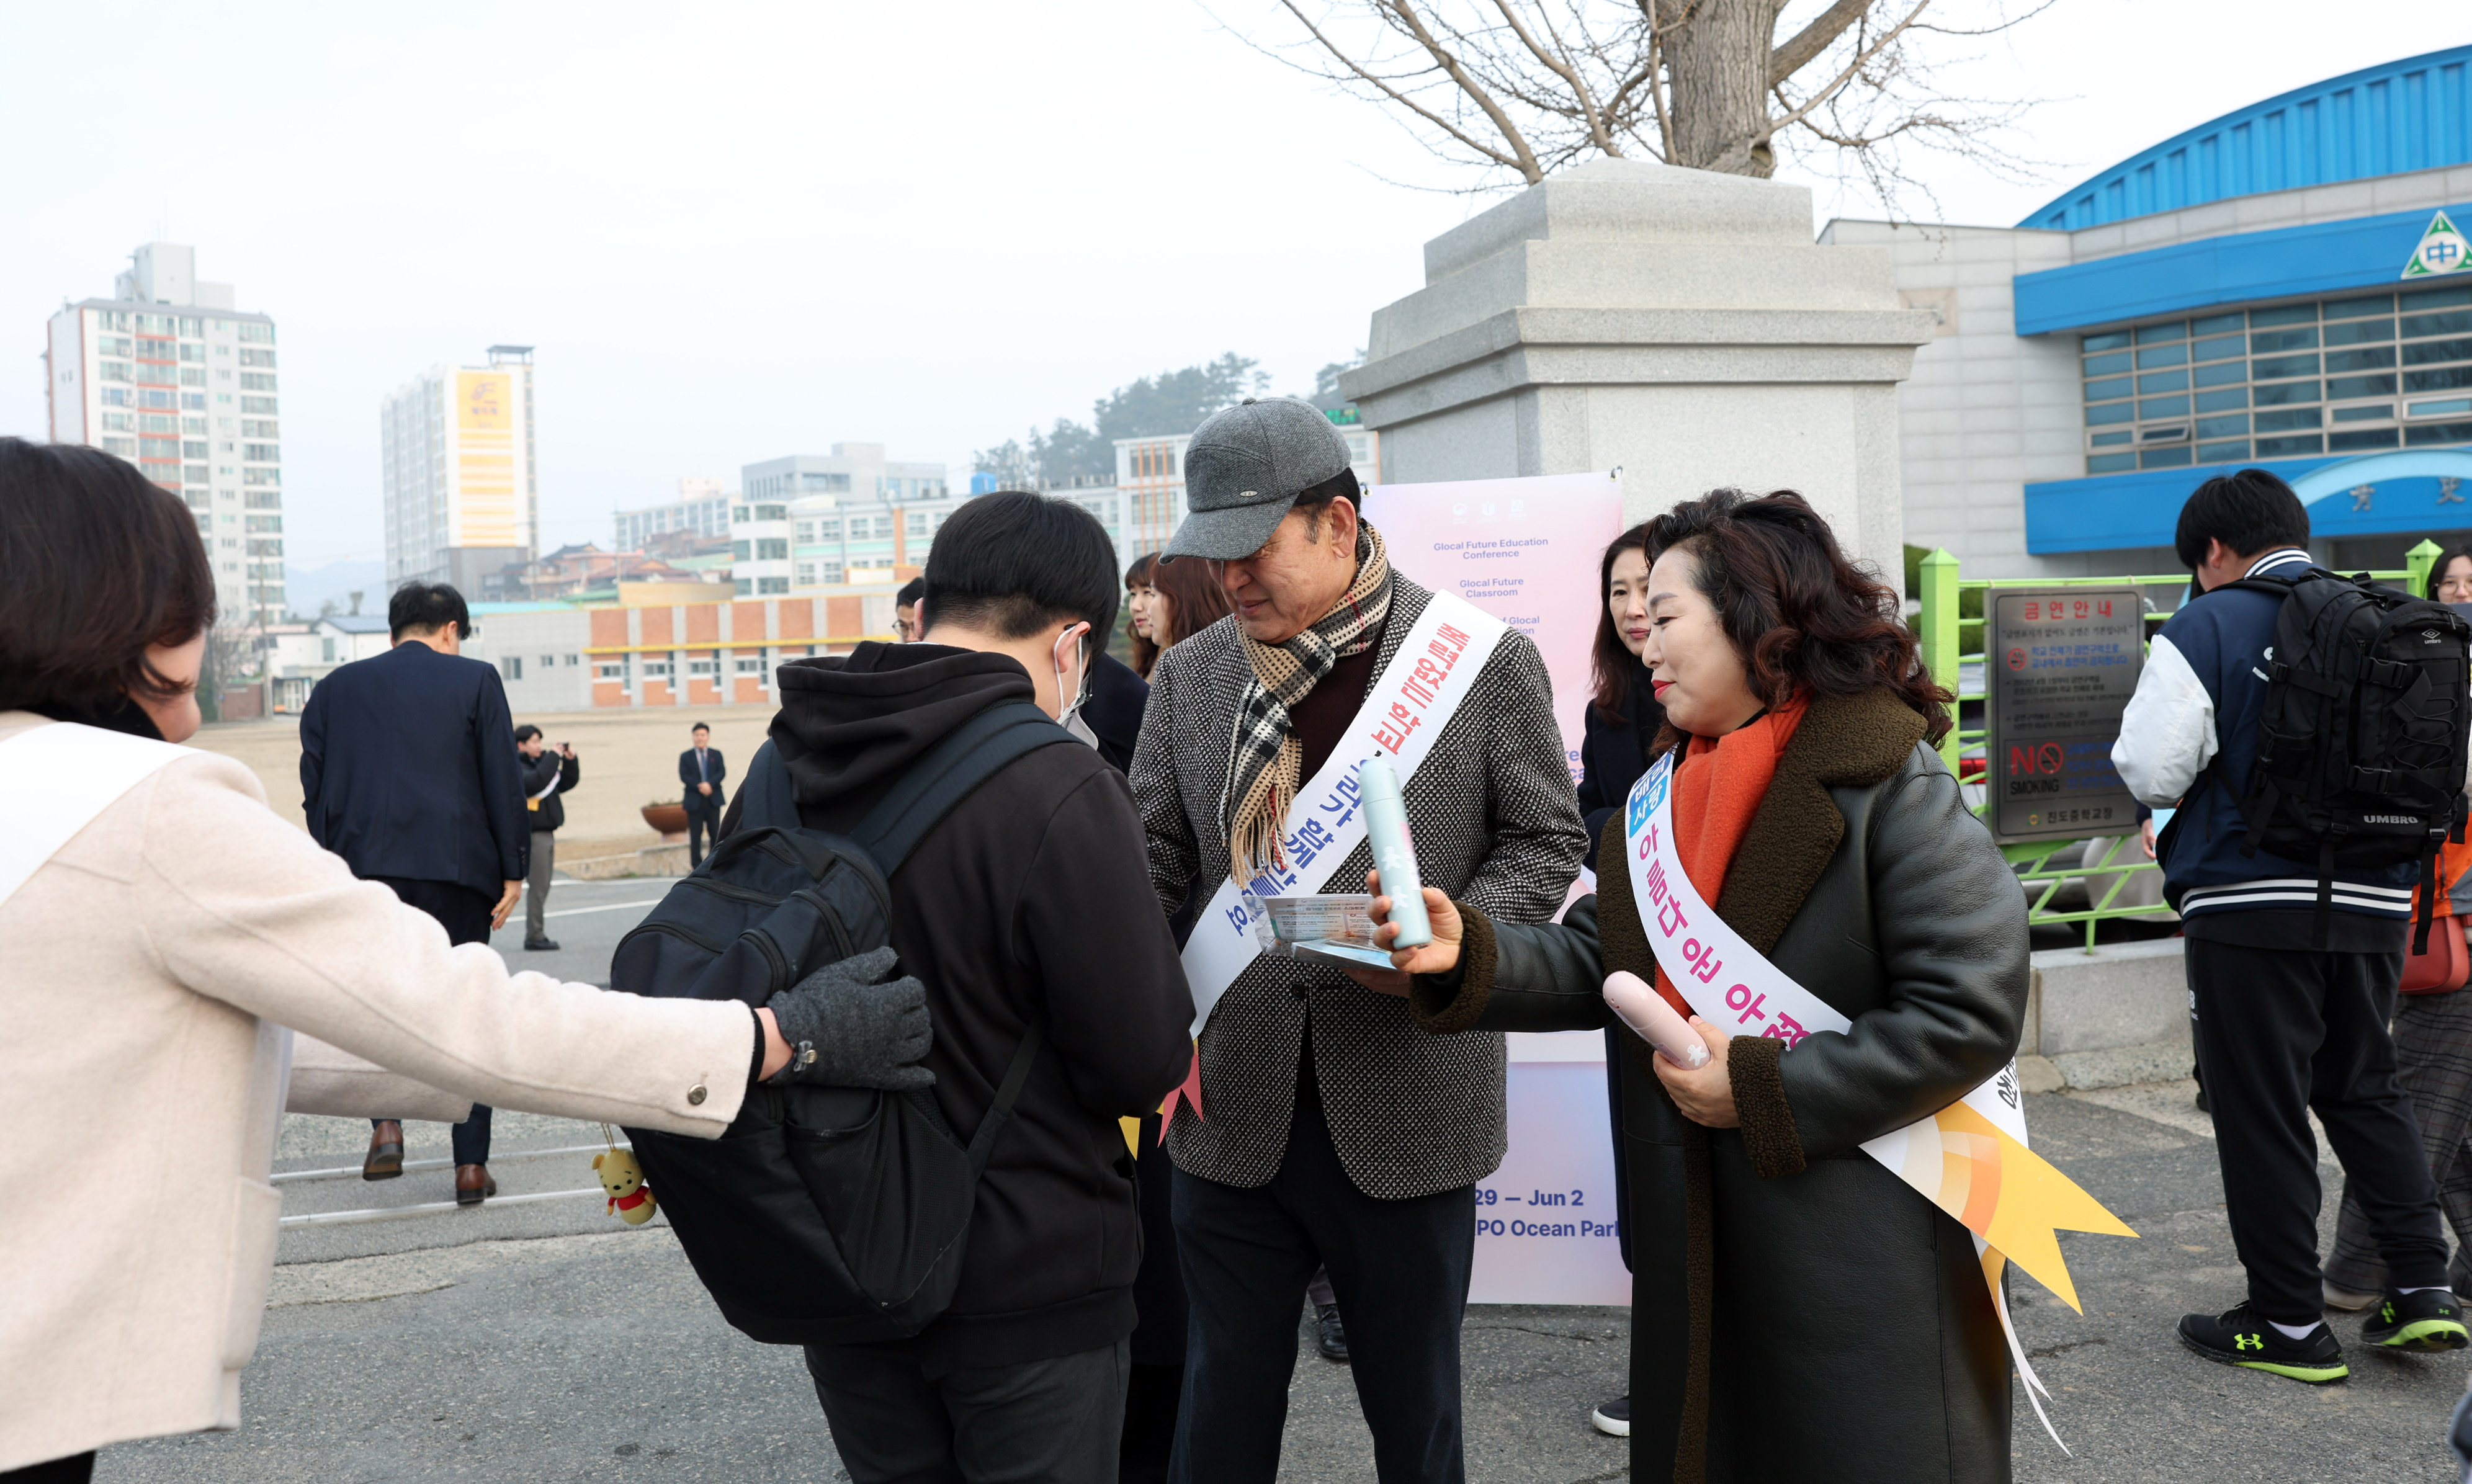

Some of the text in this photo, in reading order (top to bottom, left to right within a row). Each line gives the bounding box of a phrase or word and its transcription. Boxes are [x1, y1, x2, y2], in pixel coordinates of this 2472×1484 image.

[2427, 241, 2457, 263] 中
[1434, 538, 1549, 551] Glocal Future Education
[1462, 550, 1520, 560] Conference
[1459, 578, 1524, 588] Glocal Future
[1466, 589, 1518, 598] Classroom
[1509, 615, 1540, 625] Glocal
[1400, 623, 1471, 709] 폭력없는
[2010, 779, 2059, 795] SMOKING
[1634, 783, 1663, 826] 사랑
[2363, 815, 2418, 824] UMBRO
[1286, 818, 1334, 870] 함께
[1639, 823, 1722, 984] 아름다운
[1528, 1190, 1565, 1206] Jun
[1571, 1190, 1584, 1205] 2
[1511, 1220, 1575, 1236] Ocean
